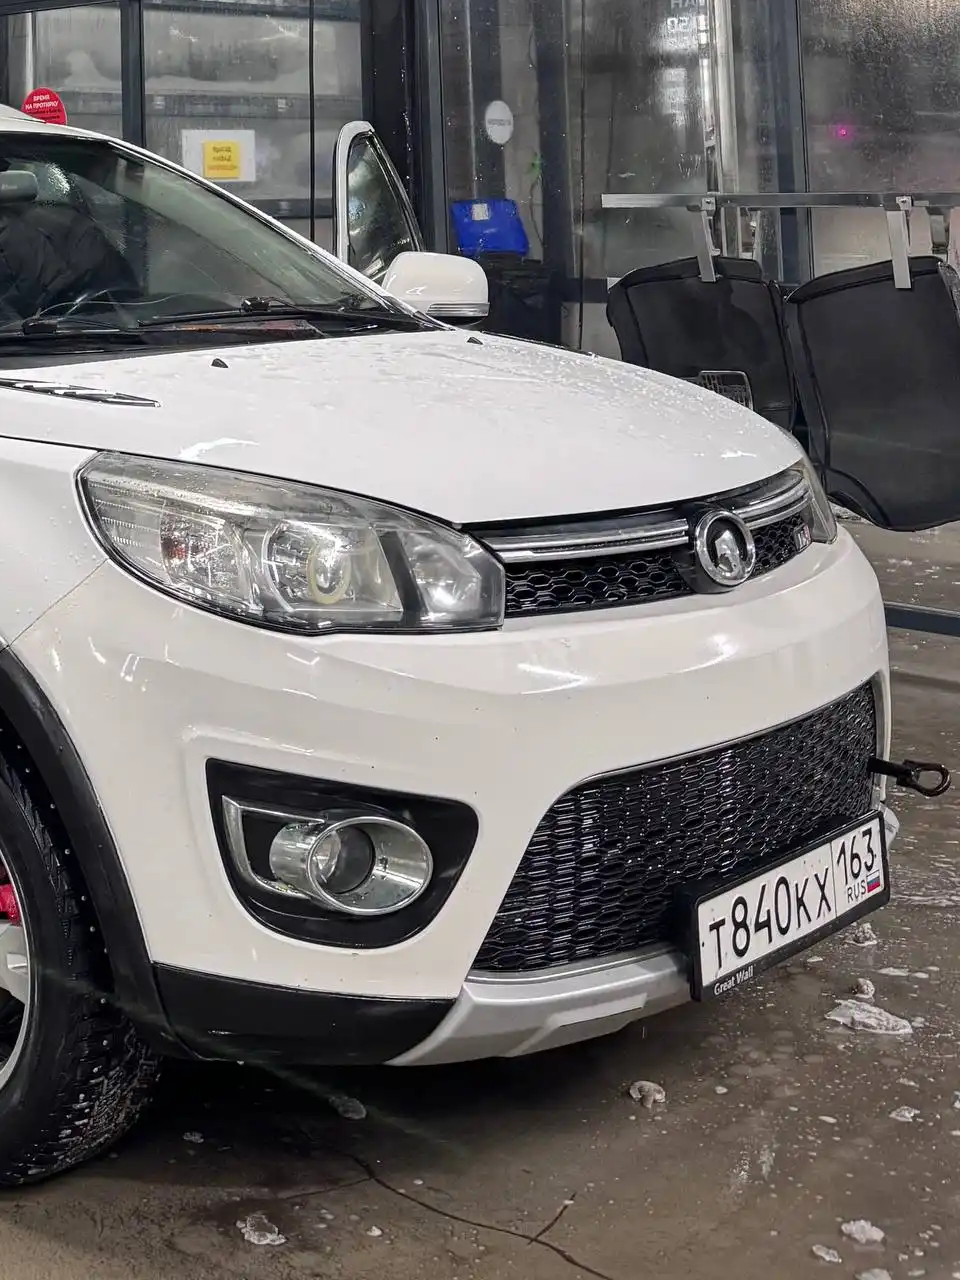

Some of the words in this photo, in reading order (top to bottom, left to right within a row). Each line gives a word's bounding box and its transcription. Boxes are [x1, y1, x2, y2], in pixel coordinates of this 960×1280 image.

[837, 827, 875, 885] 163
[846, 879, 868, 904] RUS
[714, 975, 736, 996] Great
[736, 965, 754, 984] Wall
